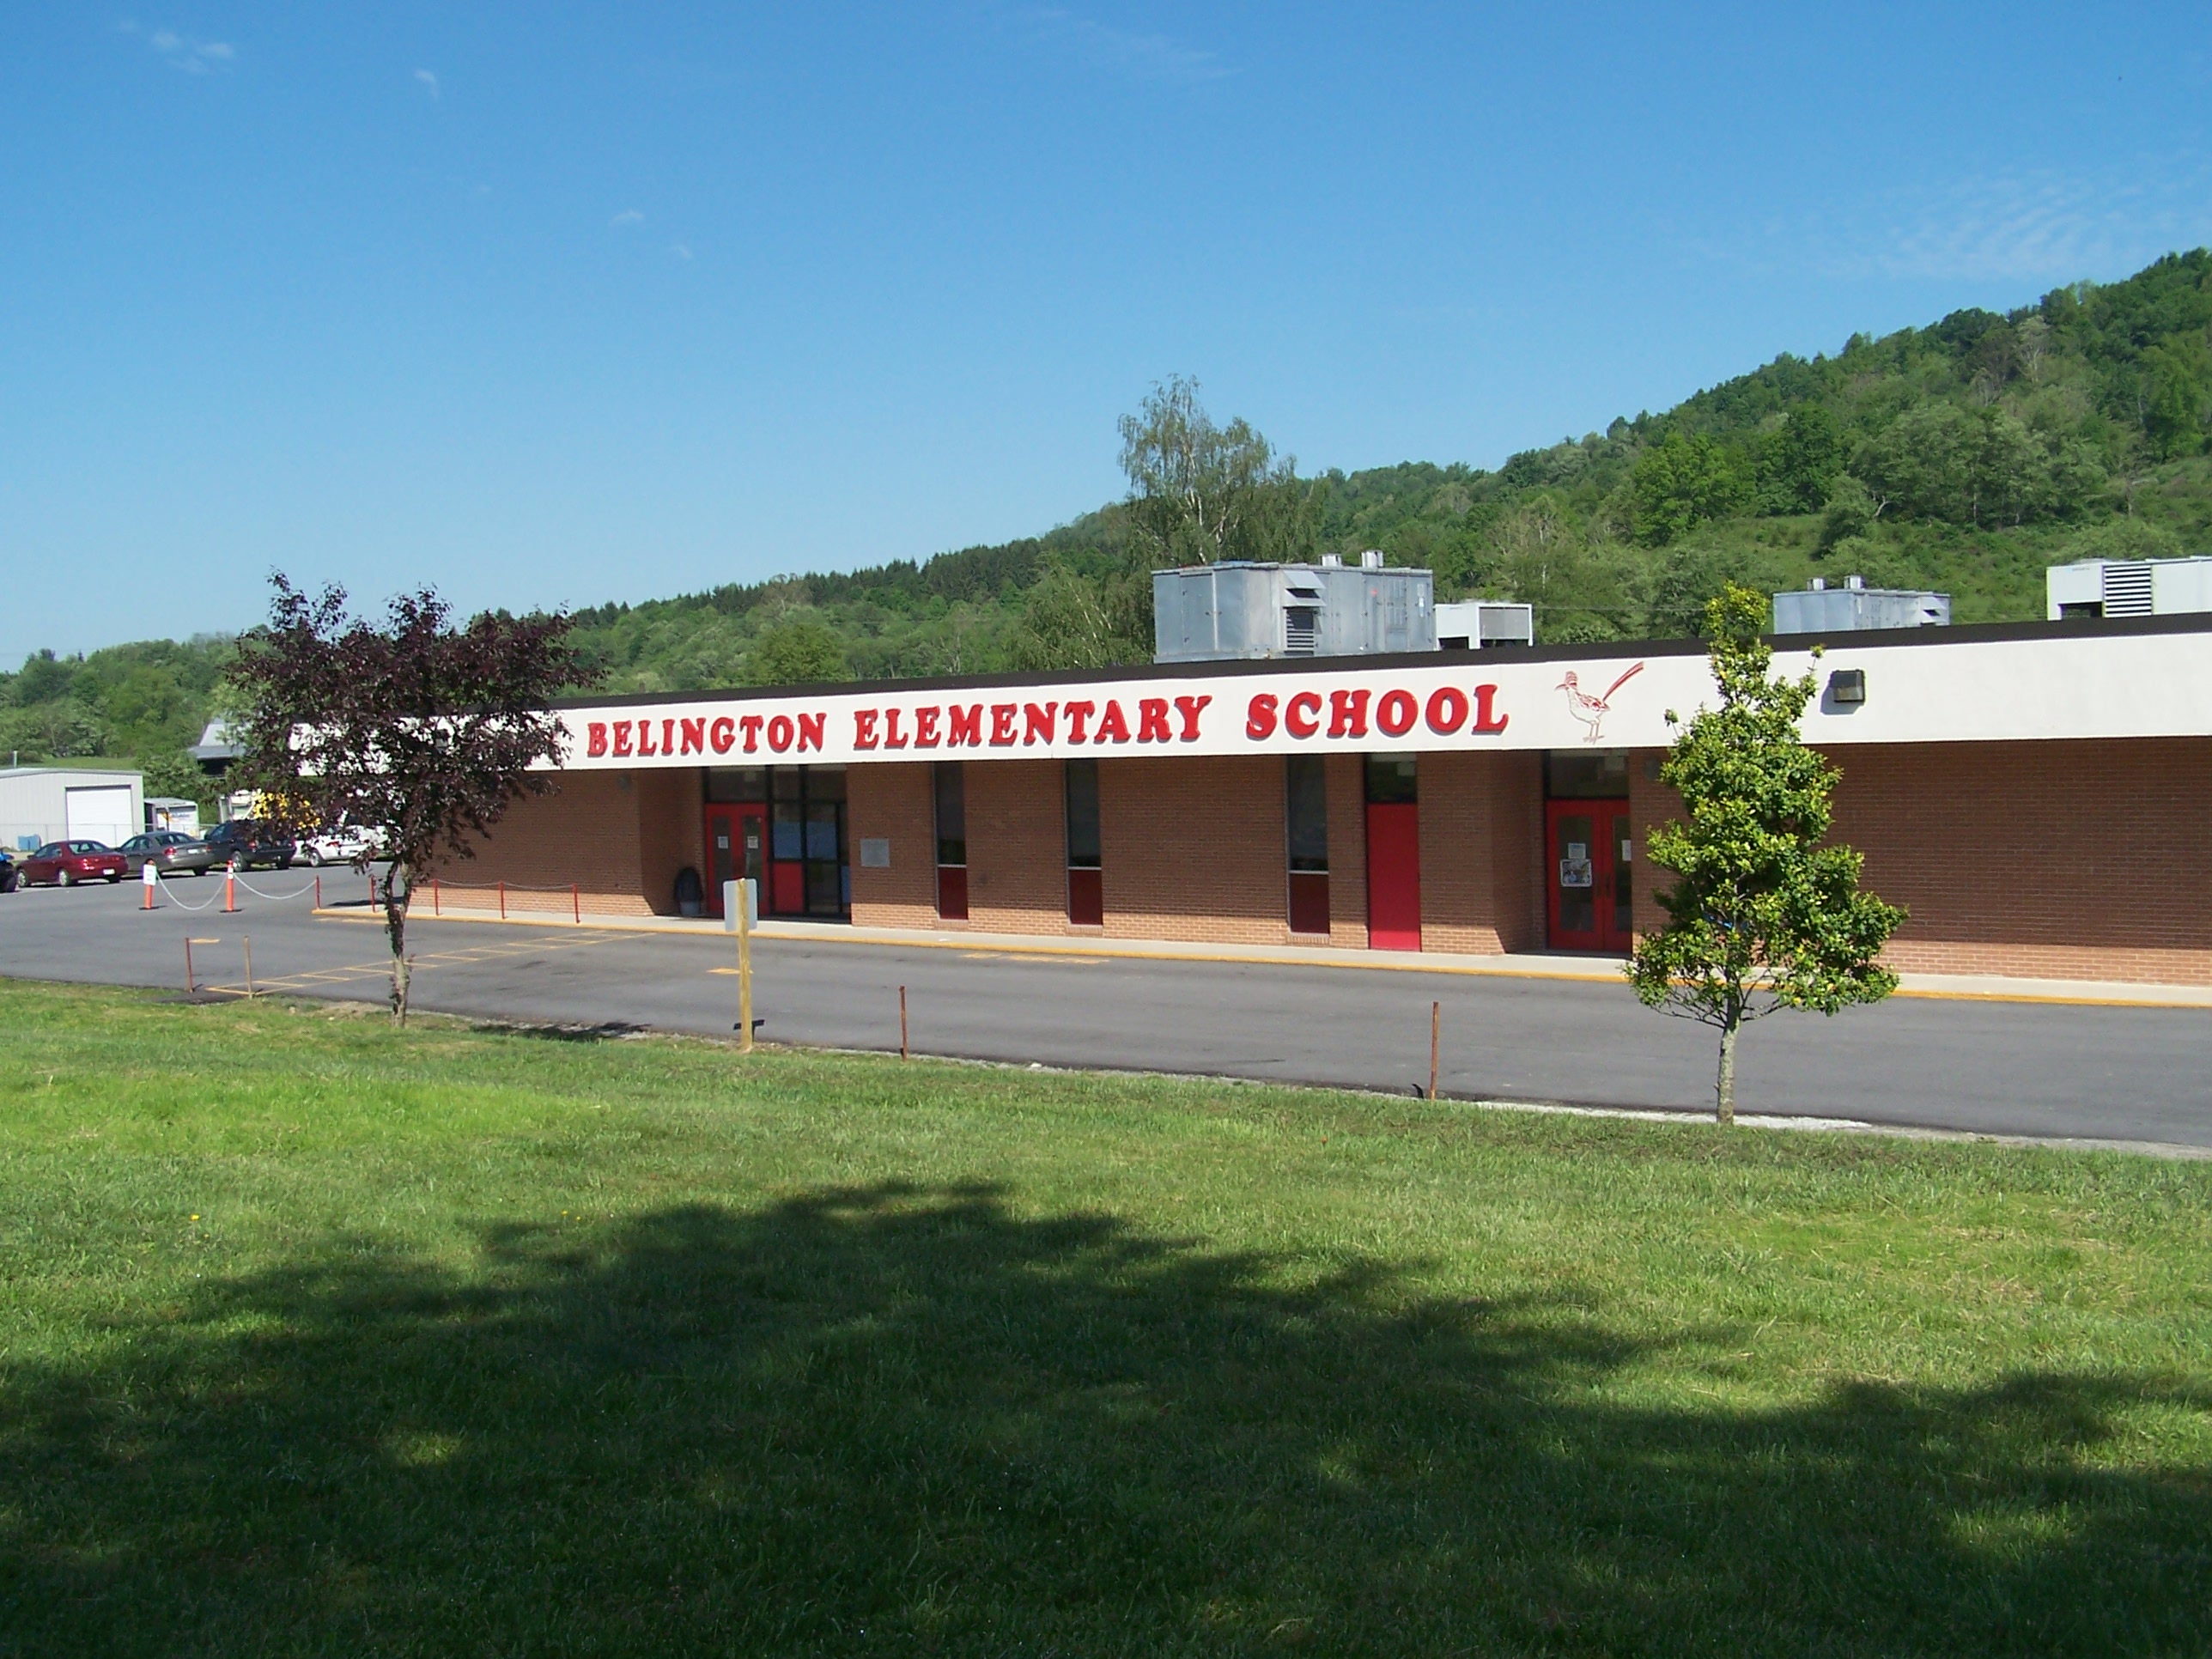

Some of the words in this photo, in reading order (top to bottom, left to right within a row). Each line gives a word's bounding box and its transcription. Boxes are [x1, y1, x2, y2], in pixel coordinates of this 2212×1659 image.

[587, 712, 827, 757] BELINGTON
[854, 694, 1212, 750] ELEMENTARY
[1246, 684, 1510, 739] SCHOOL
